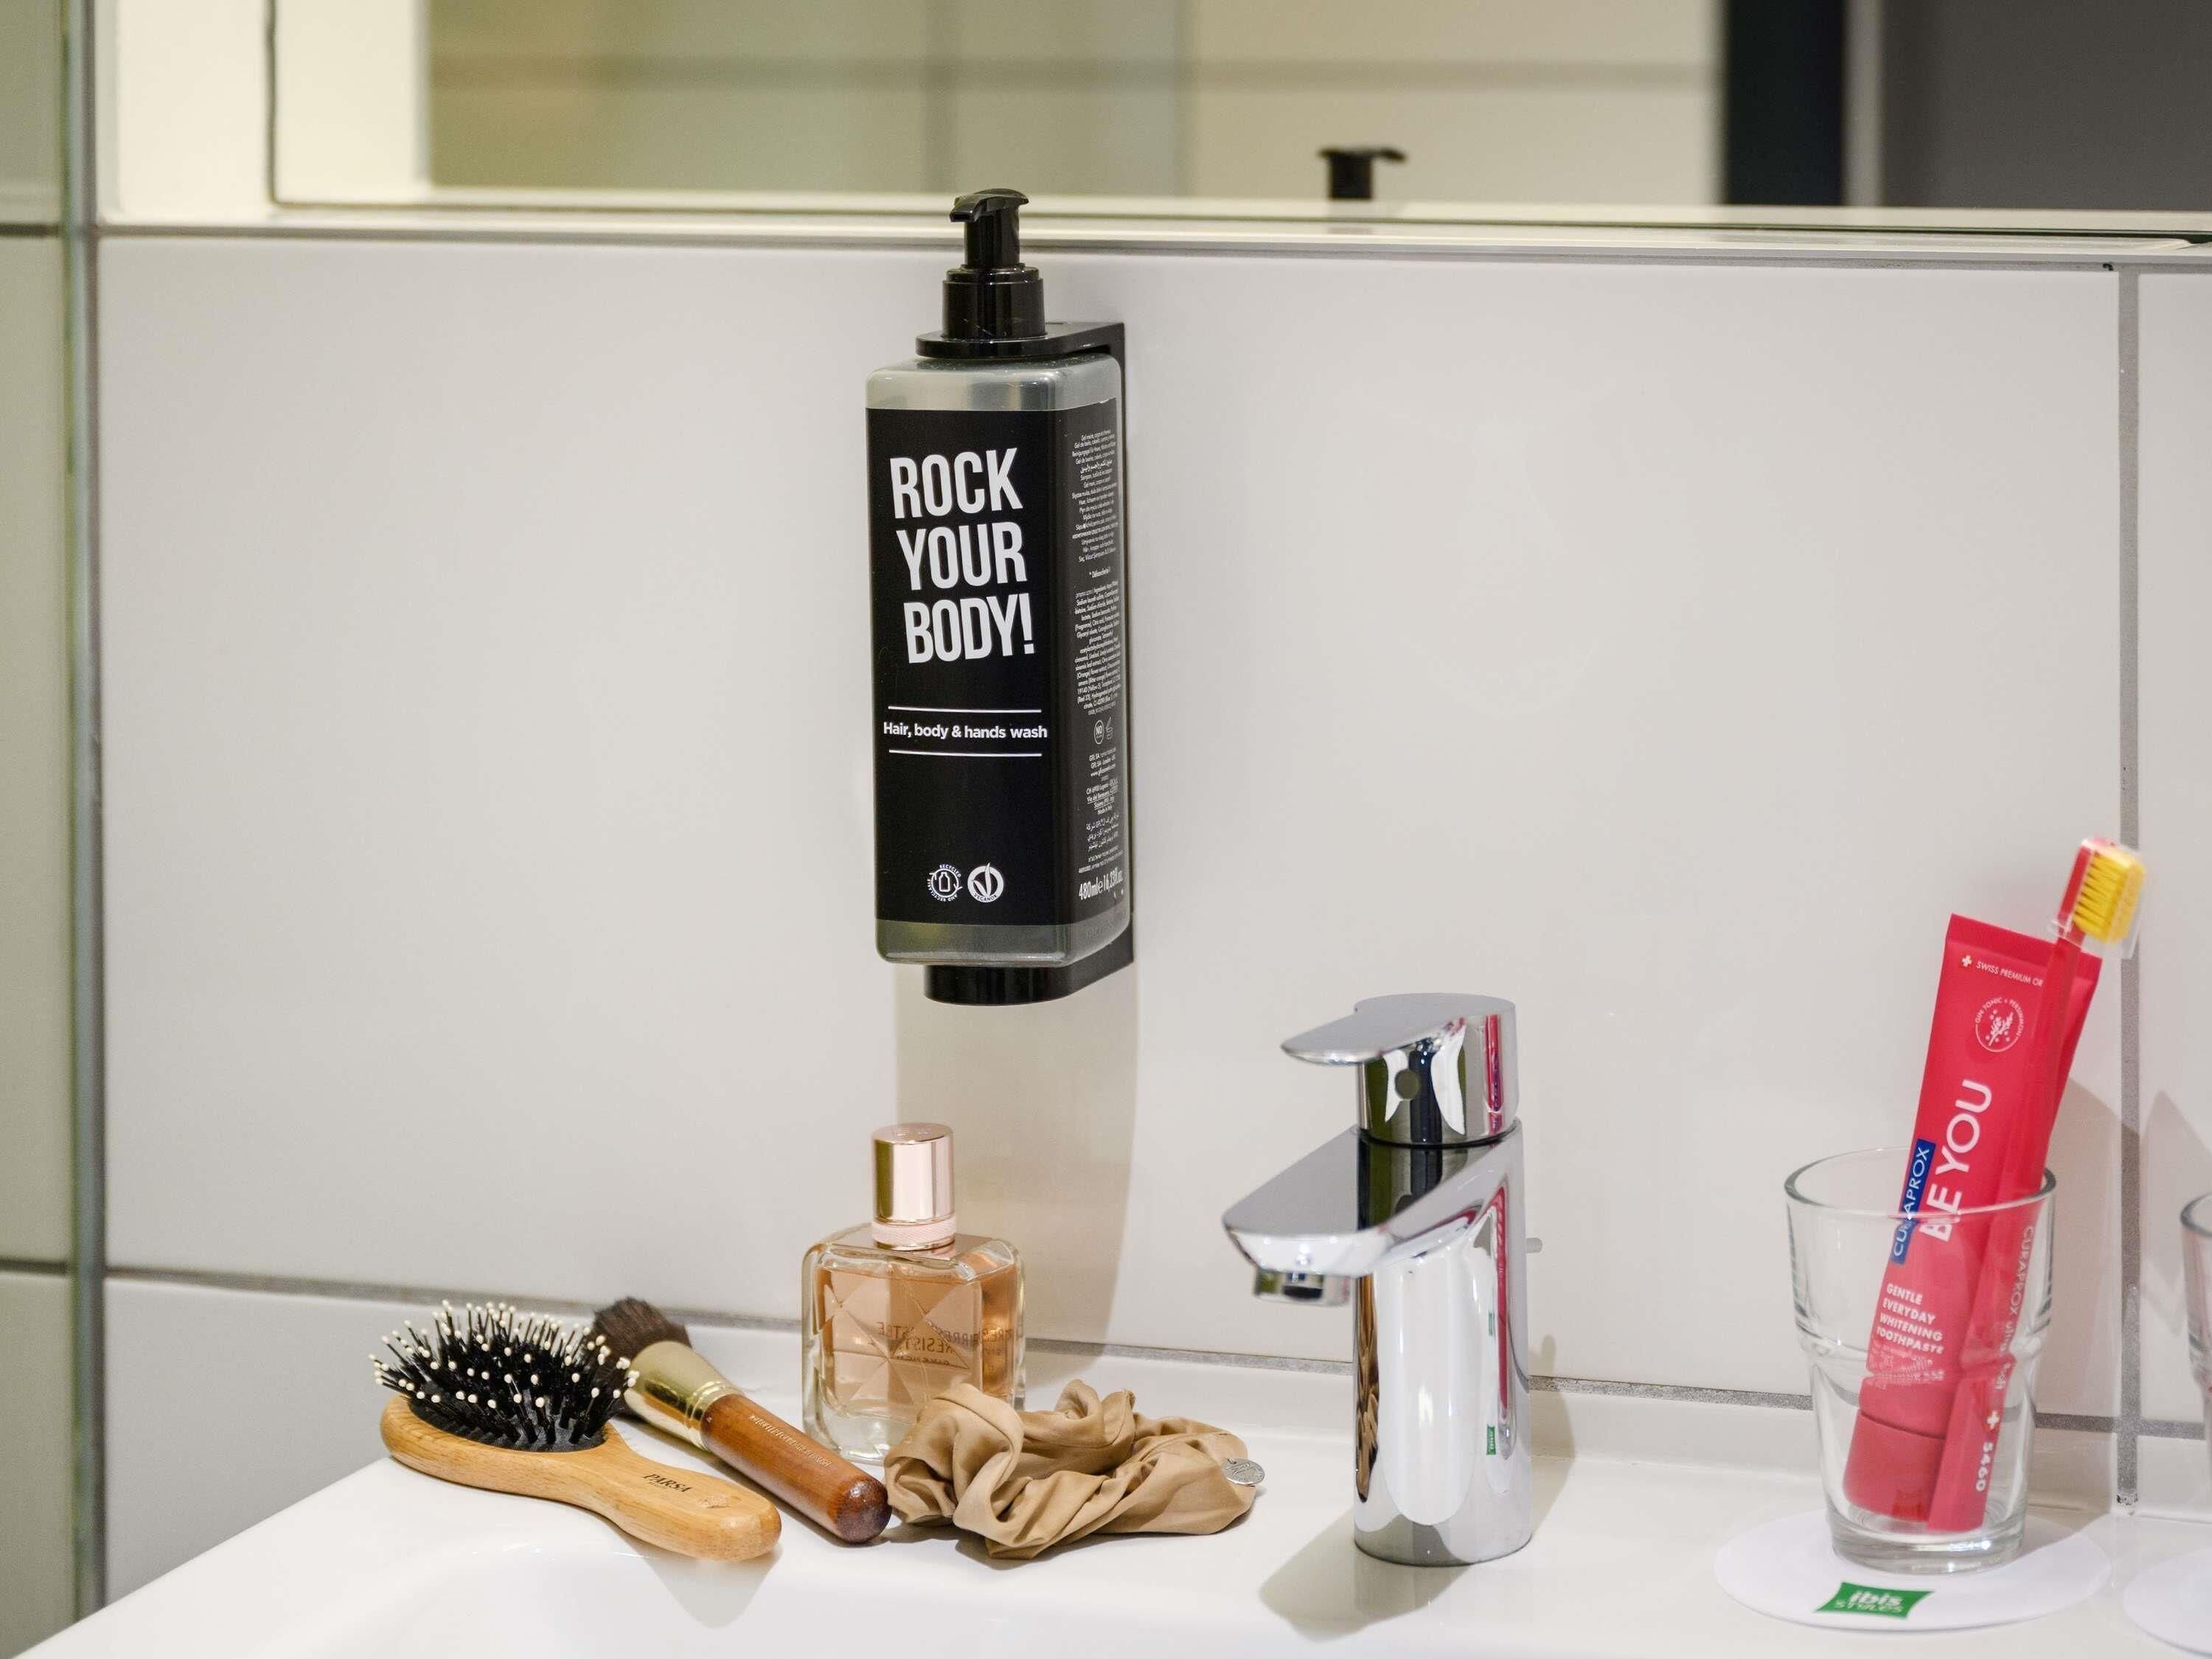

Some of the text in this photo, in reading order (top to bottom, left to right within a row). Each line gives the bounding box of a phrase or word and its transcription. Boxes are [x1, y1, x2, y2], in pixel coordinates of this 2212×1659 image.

[890, 448, 1023, 519] ROCK
[896, 521, 1028, 591] YOUR
[903, 593, 1035, 664] BODY!
[883, 722, 1048, 740] Hair, body & hands wash
[1976, 961, 1998, 975] SWISS
[2000, 968, 2030, 984] PREMIUM
[1983, 996, 2003, 1011] TONIC
[1935, 1079, 1992, 1175] YOU
[1887, 1283, 1923, 1305] GENTLE
[1882, 1298, 1935, 1324] EVERYDAY
[1877, 1326, 1944, 1354] TOOTHPASTE
[1879, 1312, 1943, 1342] WHITENING
[1976, 1442, 1993, 1492] 5460
[642, 1473, 692, 1493] PARSA
